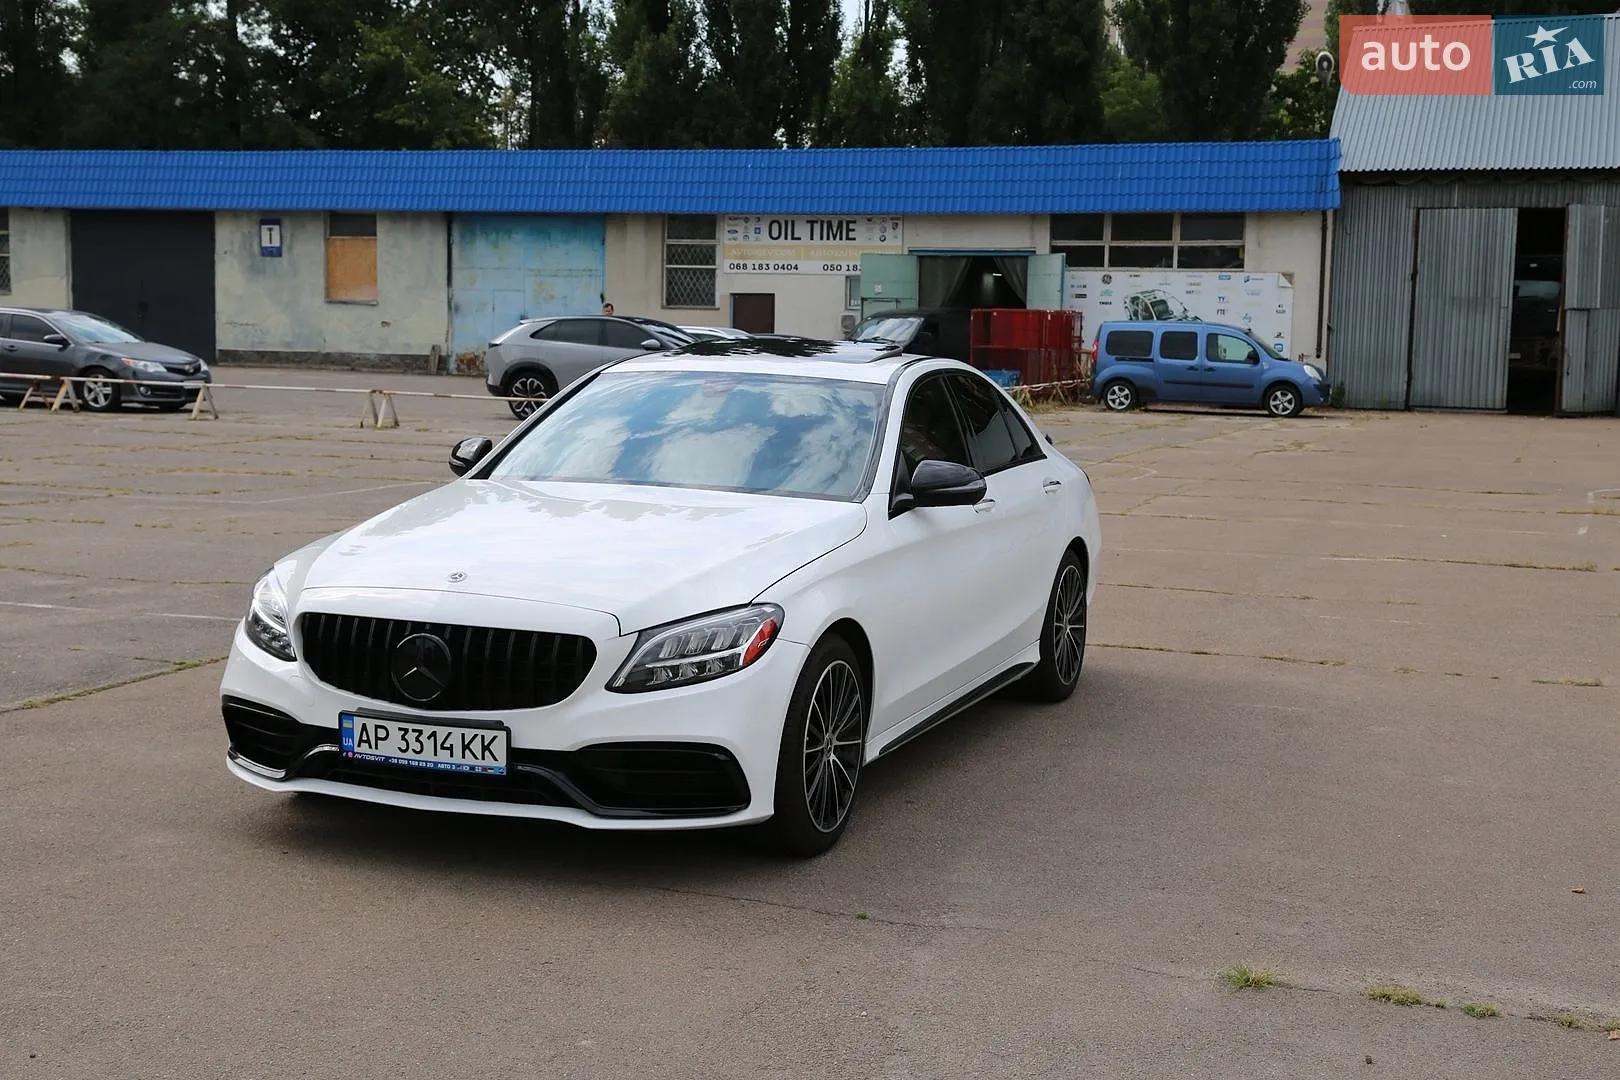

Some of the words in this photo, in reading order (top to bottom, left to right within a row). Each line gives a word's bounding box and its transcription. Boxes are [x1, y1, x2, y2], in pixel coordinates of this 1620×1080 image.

[768, 219, 801, 241] OIL
[806, 219, 857, 241] TIME
[729, 263, 748, 271] 068
[751, 263, 770, 271] 183
[773, 263, 799, 271] 0404
[822, 264, 842, 272] 050
[845, 264, 861, 272] 18
[343, 737, 354, 747] UA
[357, 722, 390, 751] AP
[397, 727, 454, 759] 3314
[461, 732, 499, 762] KK
